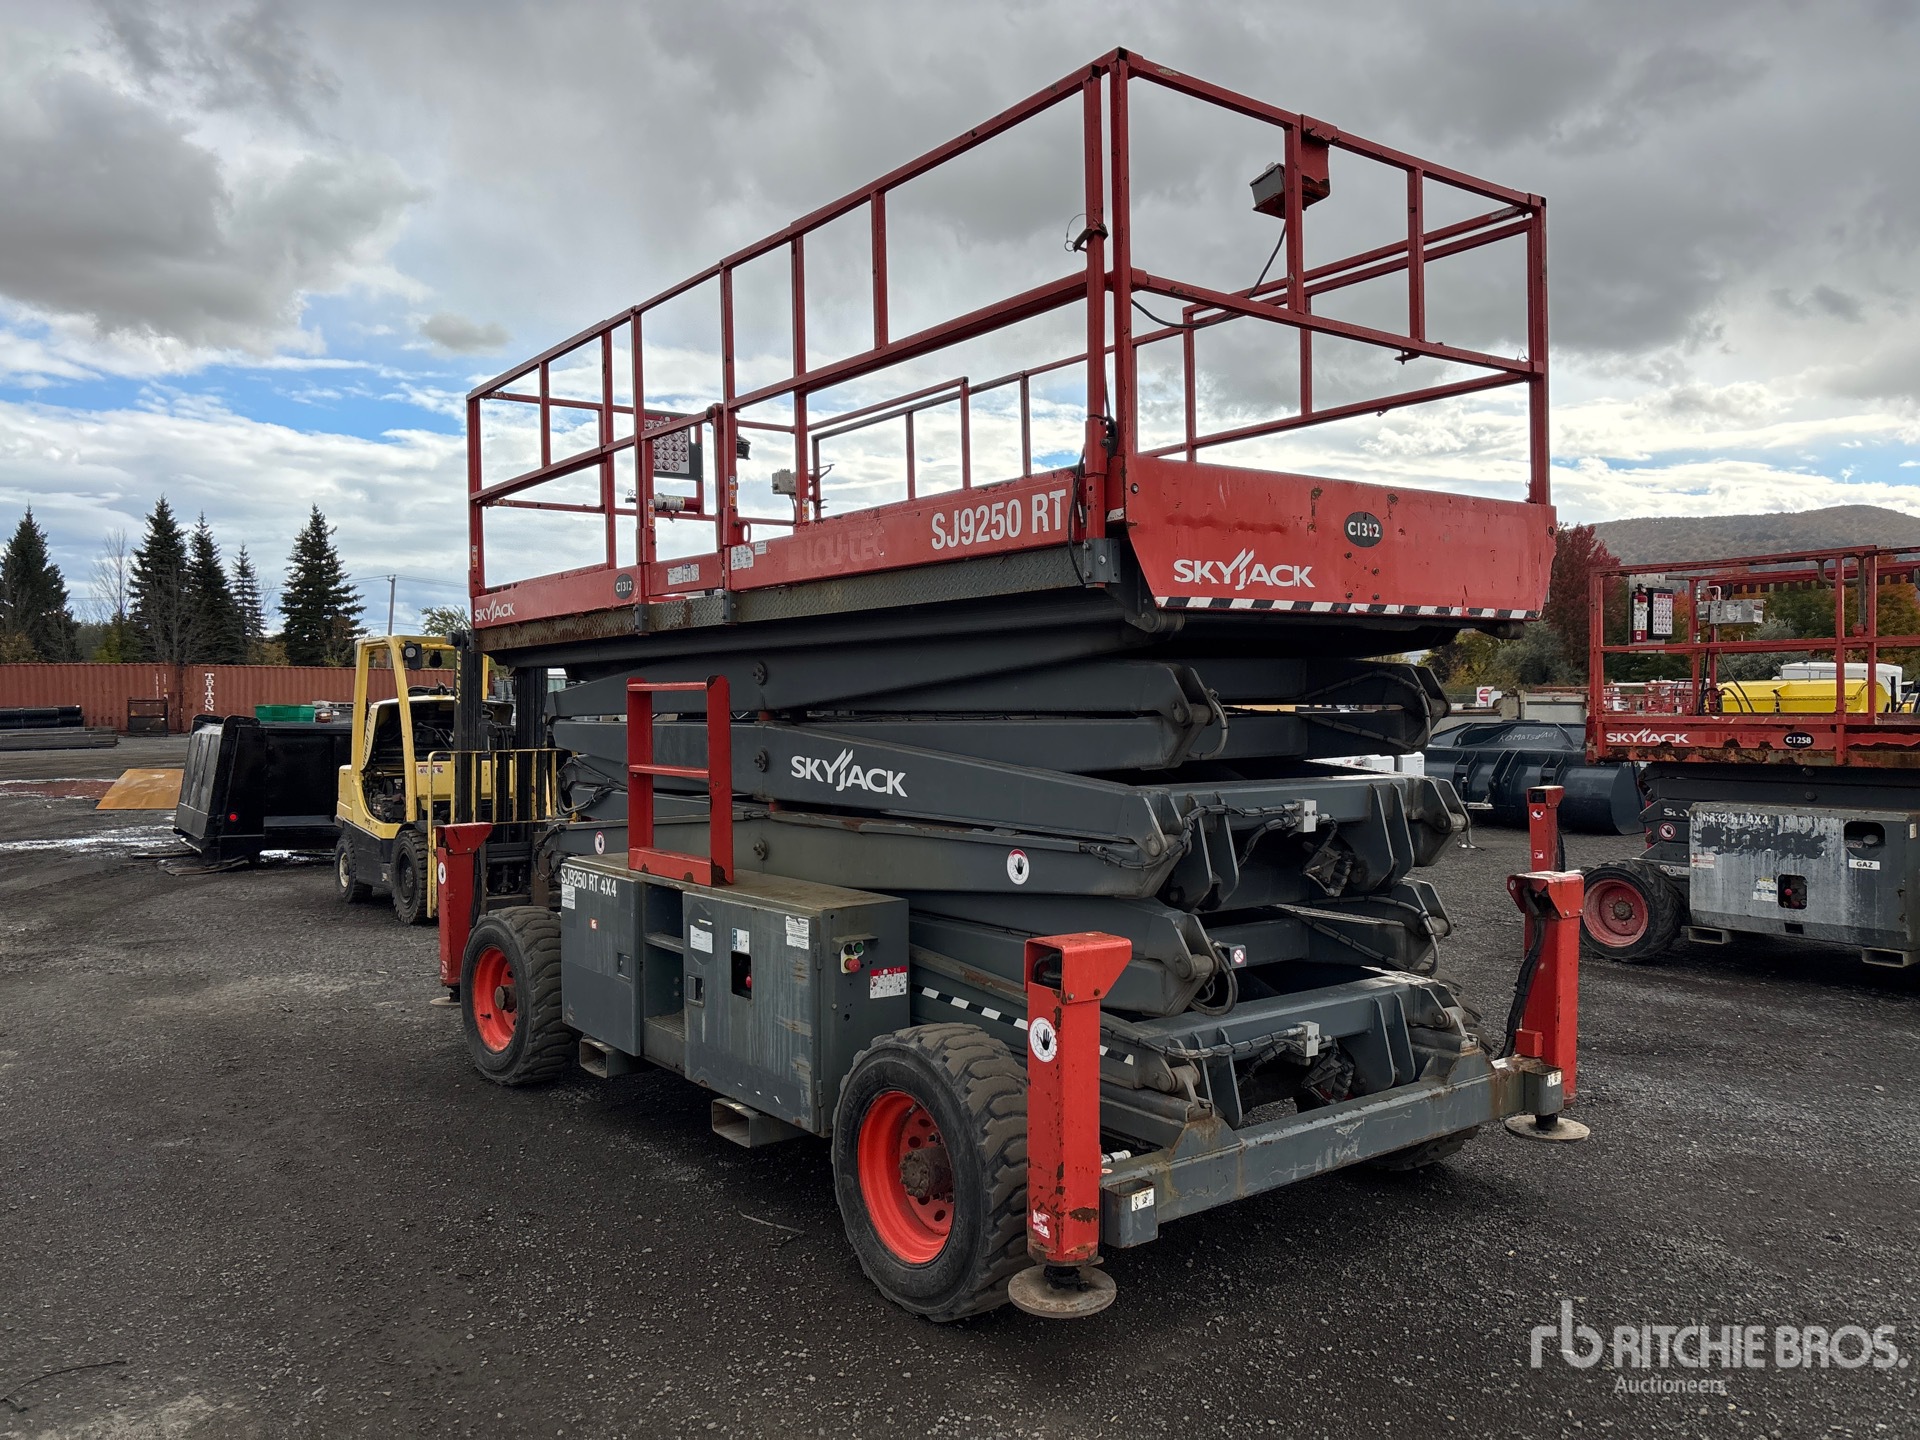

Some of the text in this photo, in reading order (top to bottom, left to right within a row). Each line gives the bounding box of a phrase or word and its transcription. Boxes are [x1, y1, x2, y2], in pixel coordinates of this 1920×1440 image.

[931, 489, 1067, 550] SJ9250 RT
[1173, 548, 1316, 591] SKYJACK
[615, 580, 633, 593] C1312
[475, 598, 516, 623] SKYJACK
[204, 672, 215, 711] TRITON
[1785, 736, 1812, 745] C1258
[790, 747, 909, 798] SKYJACK
[1747, 813, 1770, 825] 4X4
[1856, 861, 1873, 869] GAZ
[561, 868, 587, 890] SJ9250
[588, 873, 599, 893] RT
[600, 877, 617, 898] 4X4
